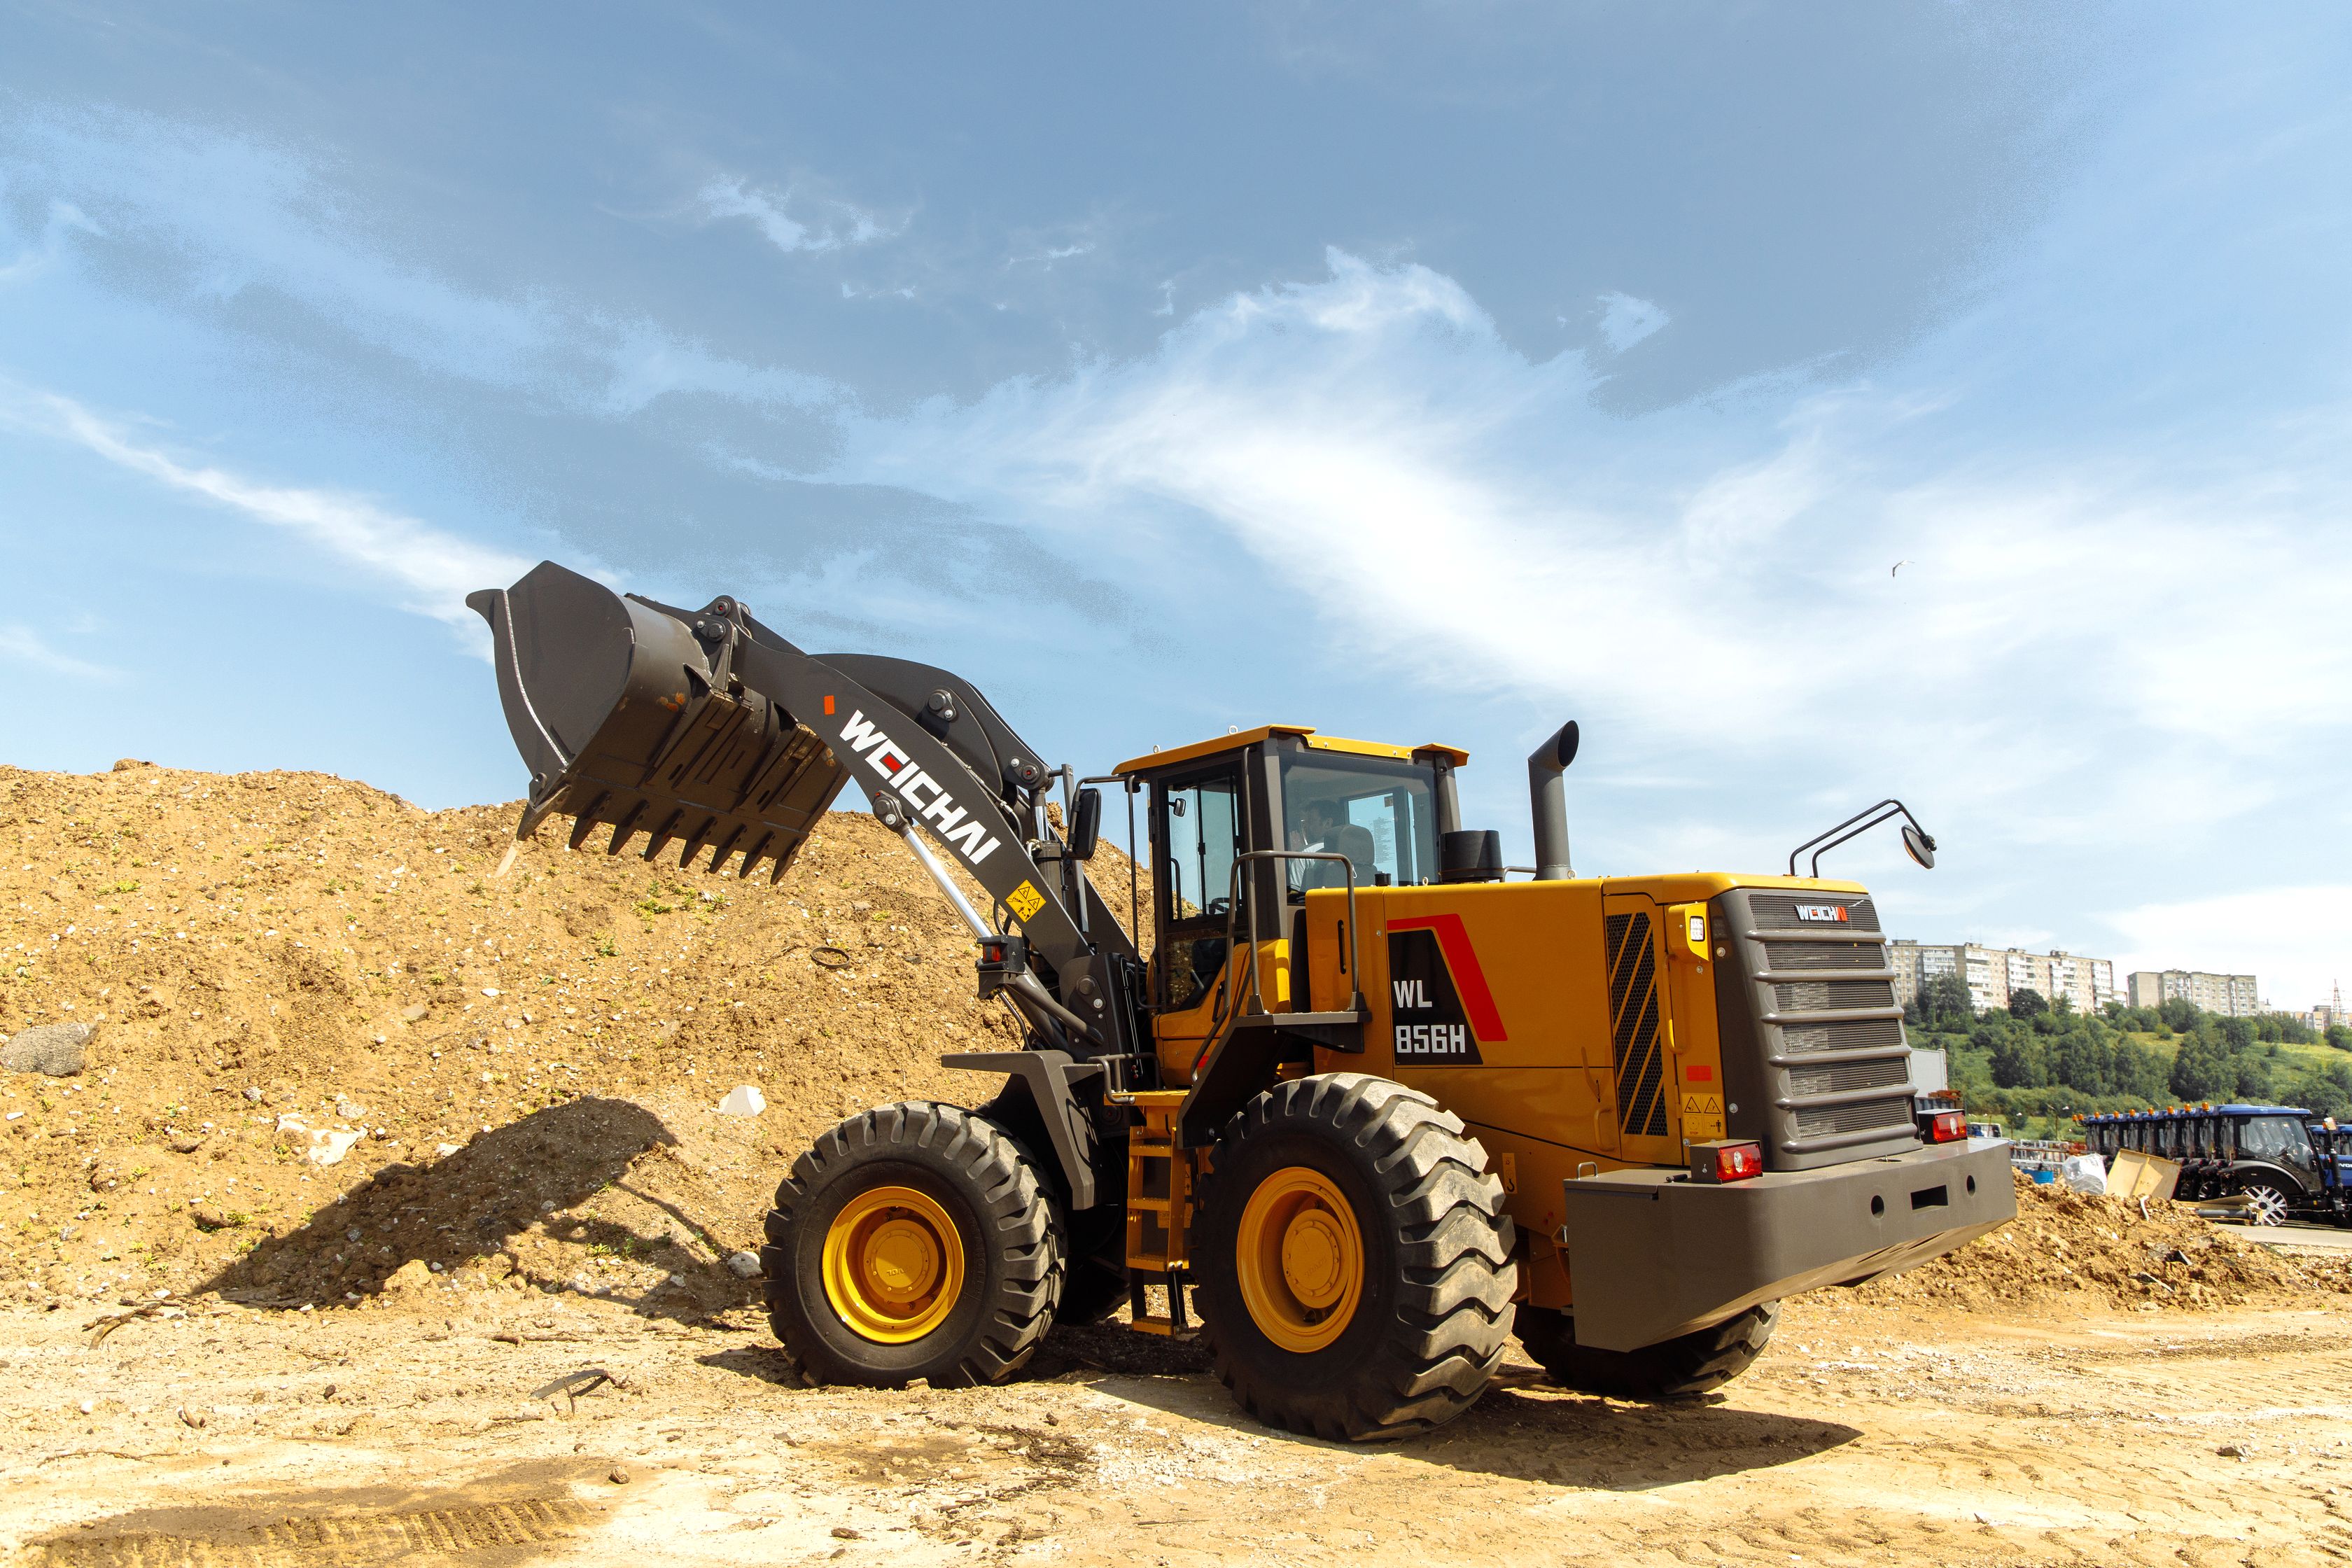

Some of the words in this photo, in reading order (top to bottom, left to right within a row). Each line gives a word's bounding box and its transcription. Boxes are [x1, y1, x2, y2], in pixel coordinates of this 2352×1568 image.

[839, 709, 1001, 865] WEICHAI
[1794, 905, 1848, 921] WEICHAI
[1394, 980, 1432, 1008] WL
[1396, 1025, 1465, 1053] 856H
